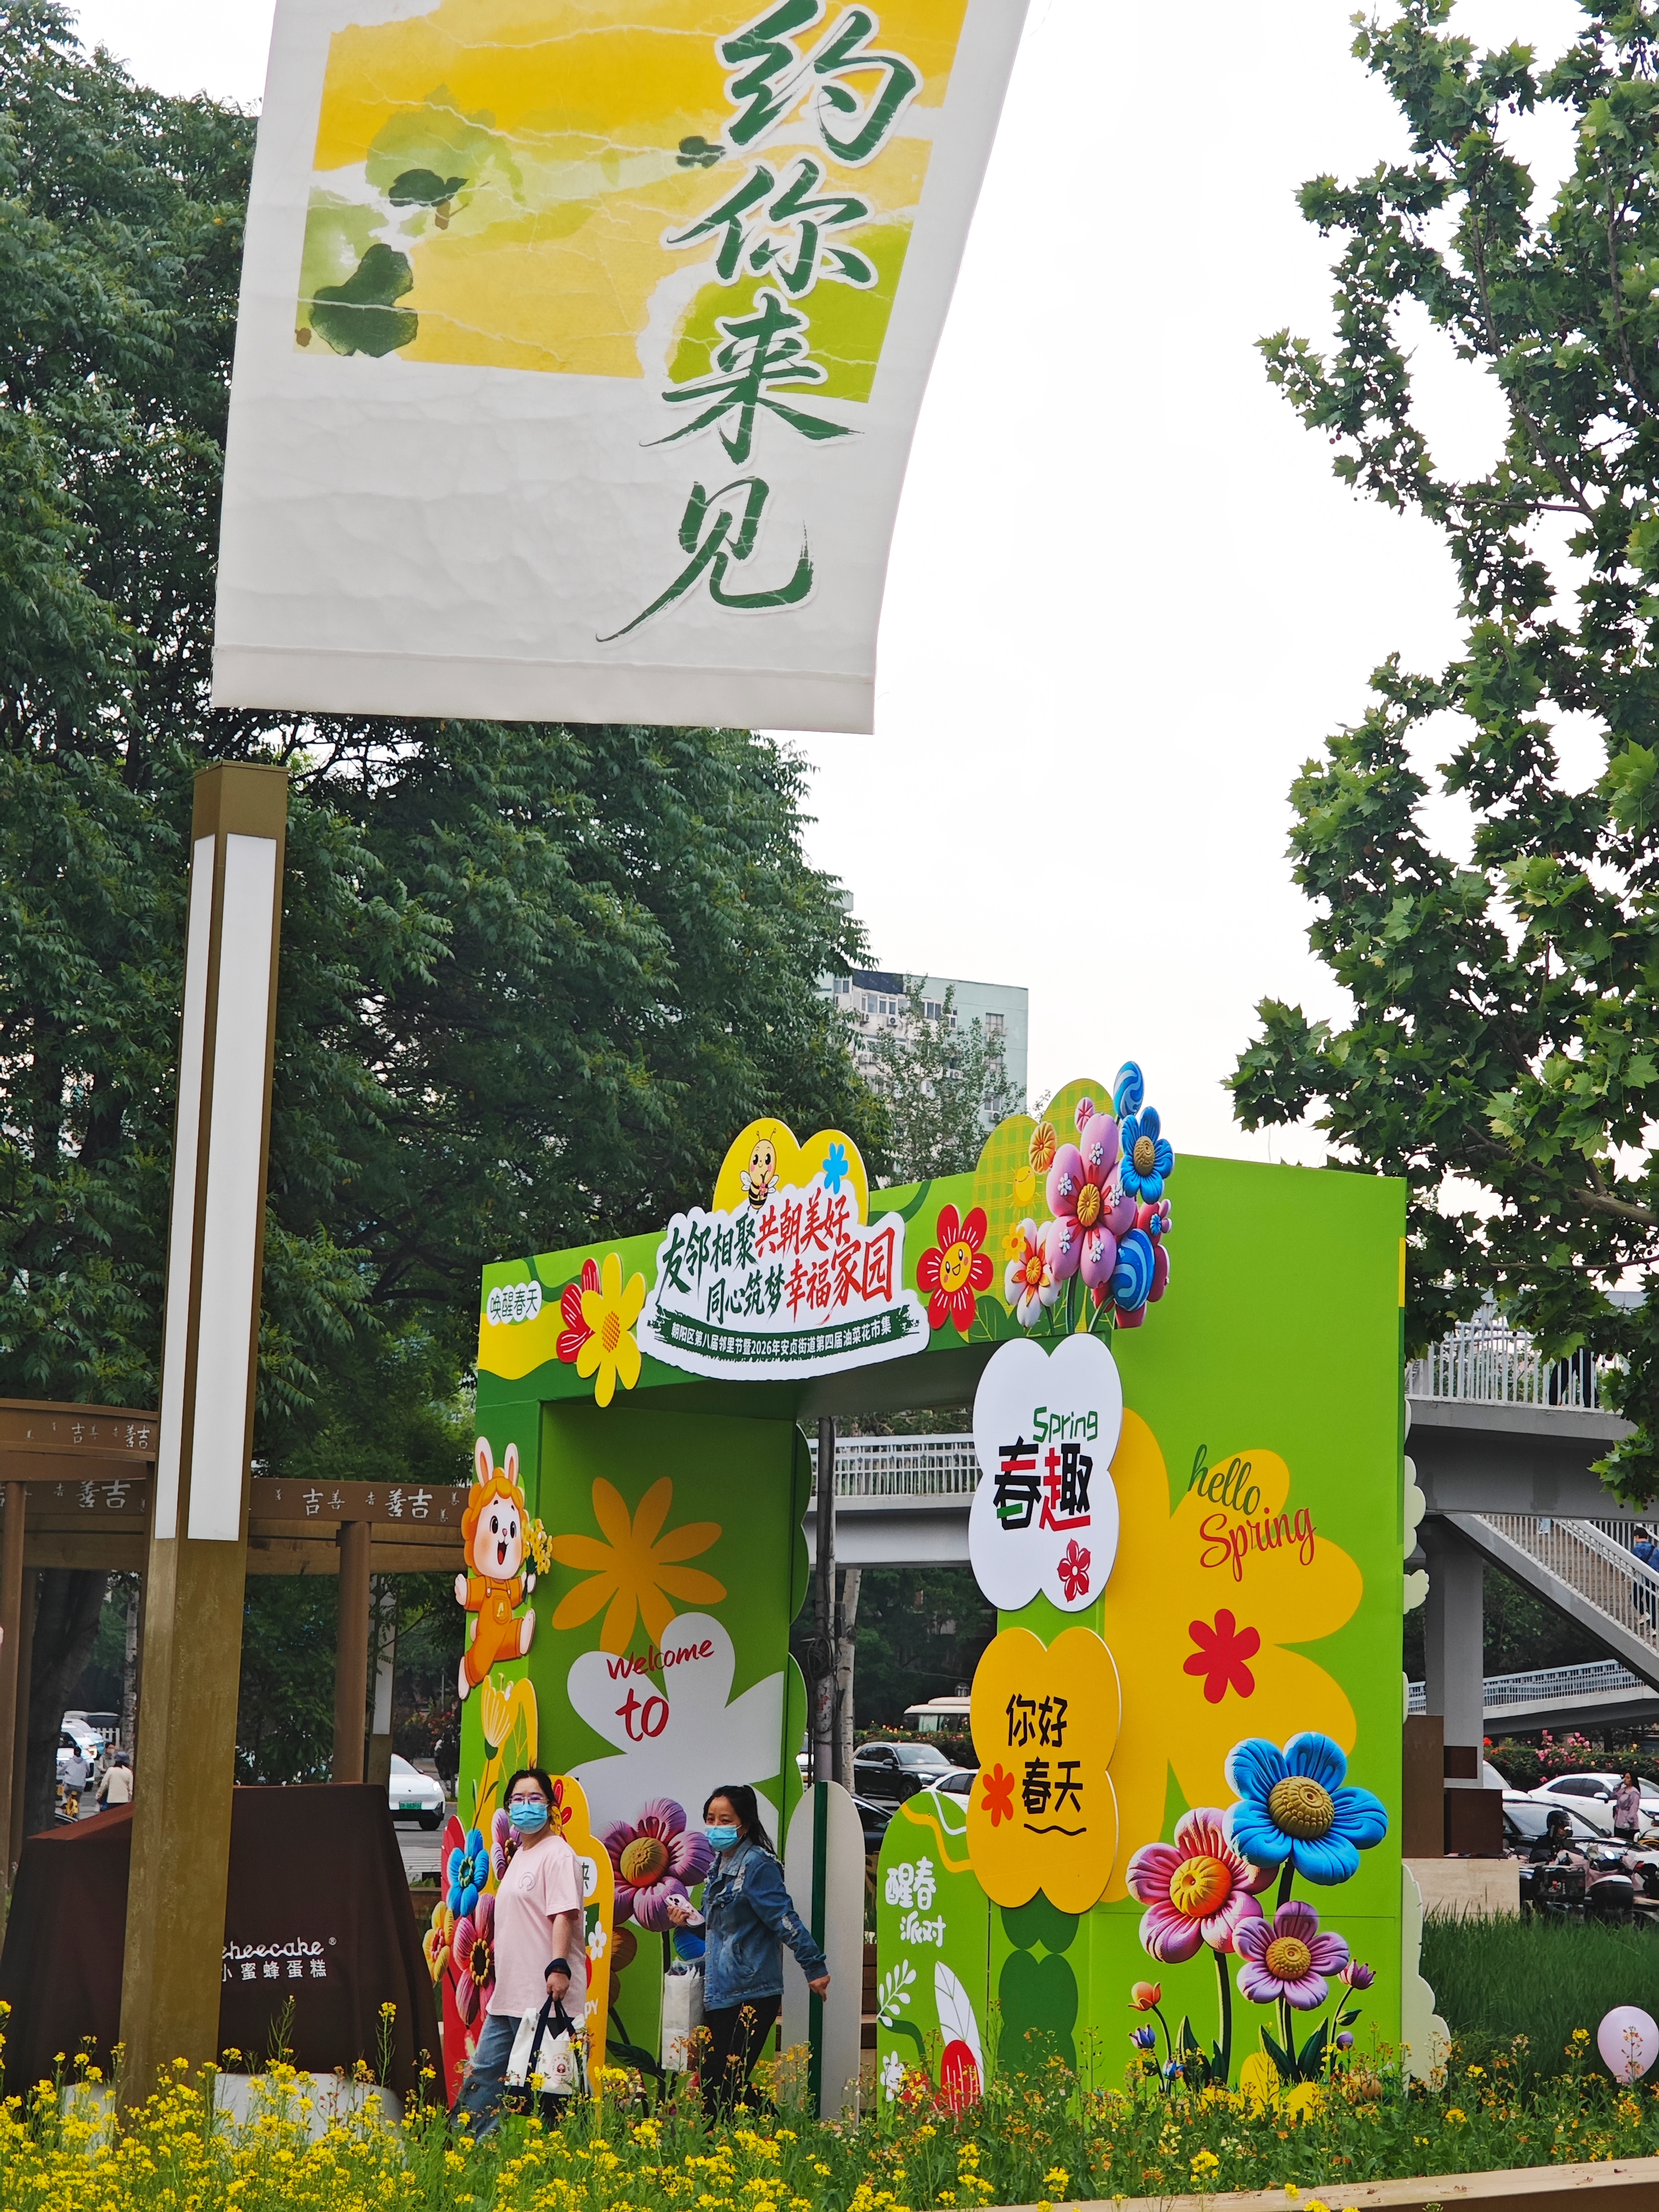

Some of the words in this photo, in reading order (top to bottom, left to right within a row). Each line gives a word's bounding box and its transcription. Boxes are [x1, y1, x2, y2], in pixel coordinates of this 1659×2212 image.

[595, 0, 916, 643] 约你来见
[490, 1289, 538, 1320] 唤醒春天
[706, 1226, 895, 1326] 同心筑梦幸福家园
[671, 1315, 892, 1357] 朝阳区第八届邻里节暨2026年安贞街道第四届油菜花市集
[1033, 1406, 1098, 1443] Spring
[993, 1435, 1093, 1532] 春趣
[1188, 1444, 1261, 1515] hello
[1199, 1507, 1316, 1582] Spring
[1006, 1692, 1068, 1749] 你好
[1021, 1755, 1084, 1815] 春天
[886, 1856, 937, 1910] 醒春
[900, 1911, 947, 1947] 派对
[221, 1958, 327, 1982] 小蜜蜂蛋糕
